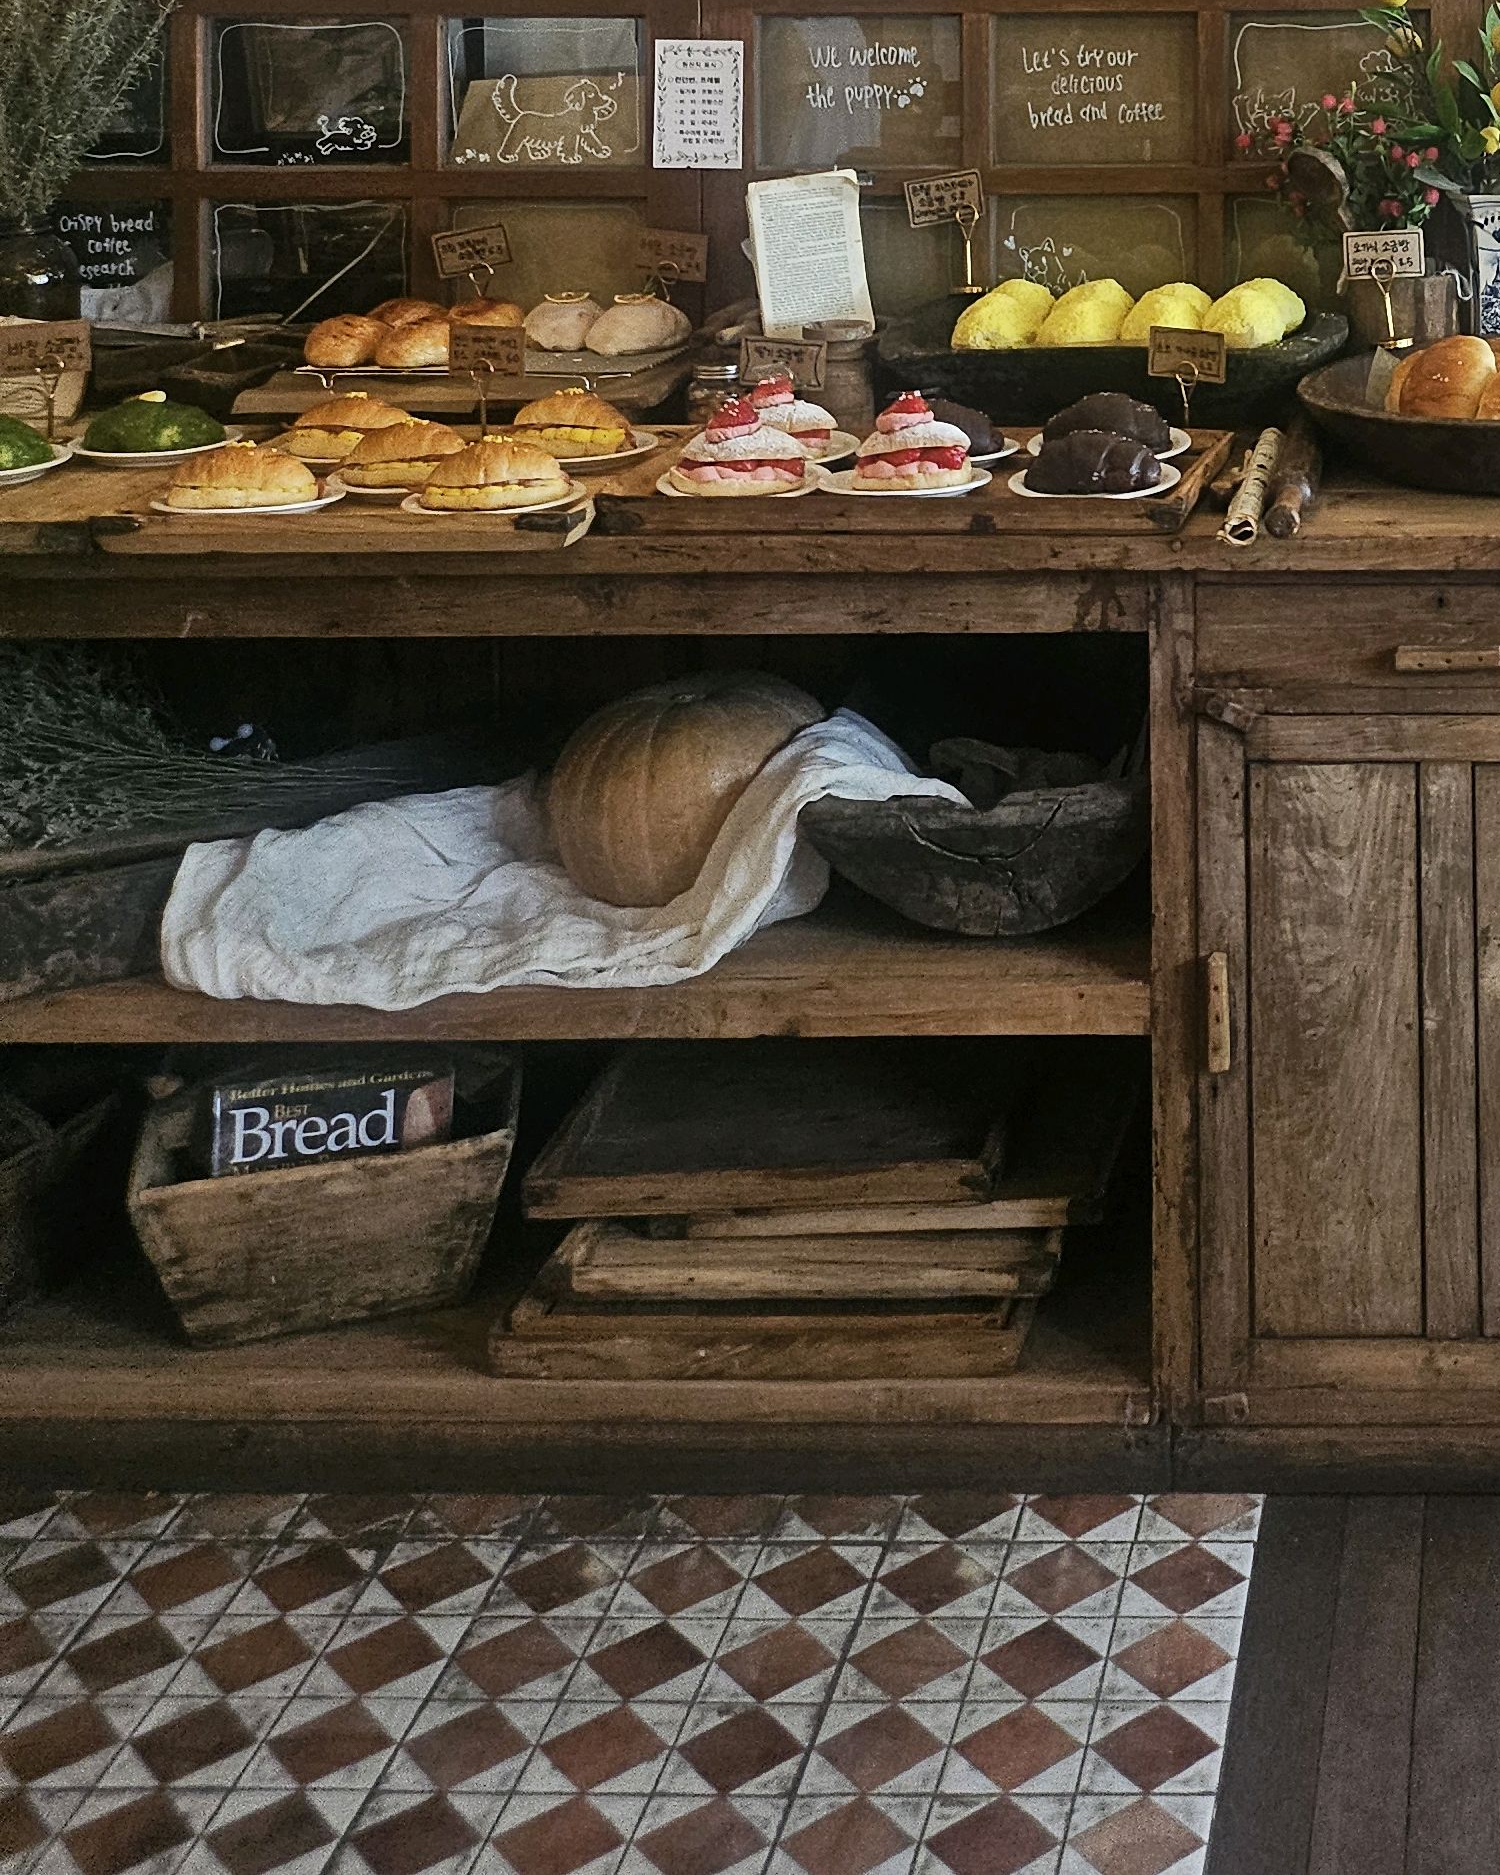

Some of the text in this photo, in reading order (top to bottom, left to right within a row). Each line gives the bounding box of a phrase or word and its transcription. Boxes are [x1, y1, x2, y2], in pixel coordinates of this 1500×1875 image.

[850, 42, 921, 68] welcome
[1022, 46, 1070, 74] Let's
[806, 82, 835, 109] the
[1051, 73, 1123, 95] delicious
[1027, 101, 1074, 130] bread
[1080, 101, 1108, 122] and
[110, 210, 154, 233] bread
[1382, 239, 1410, 253] 소금빵
[79, 258, 135, 280] esearch
[229, 1071, 434, 1102] Better Homes and Gardens
[228, 1088, 399, 1165] Bread
